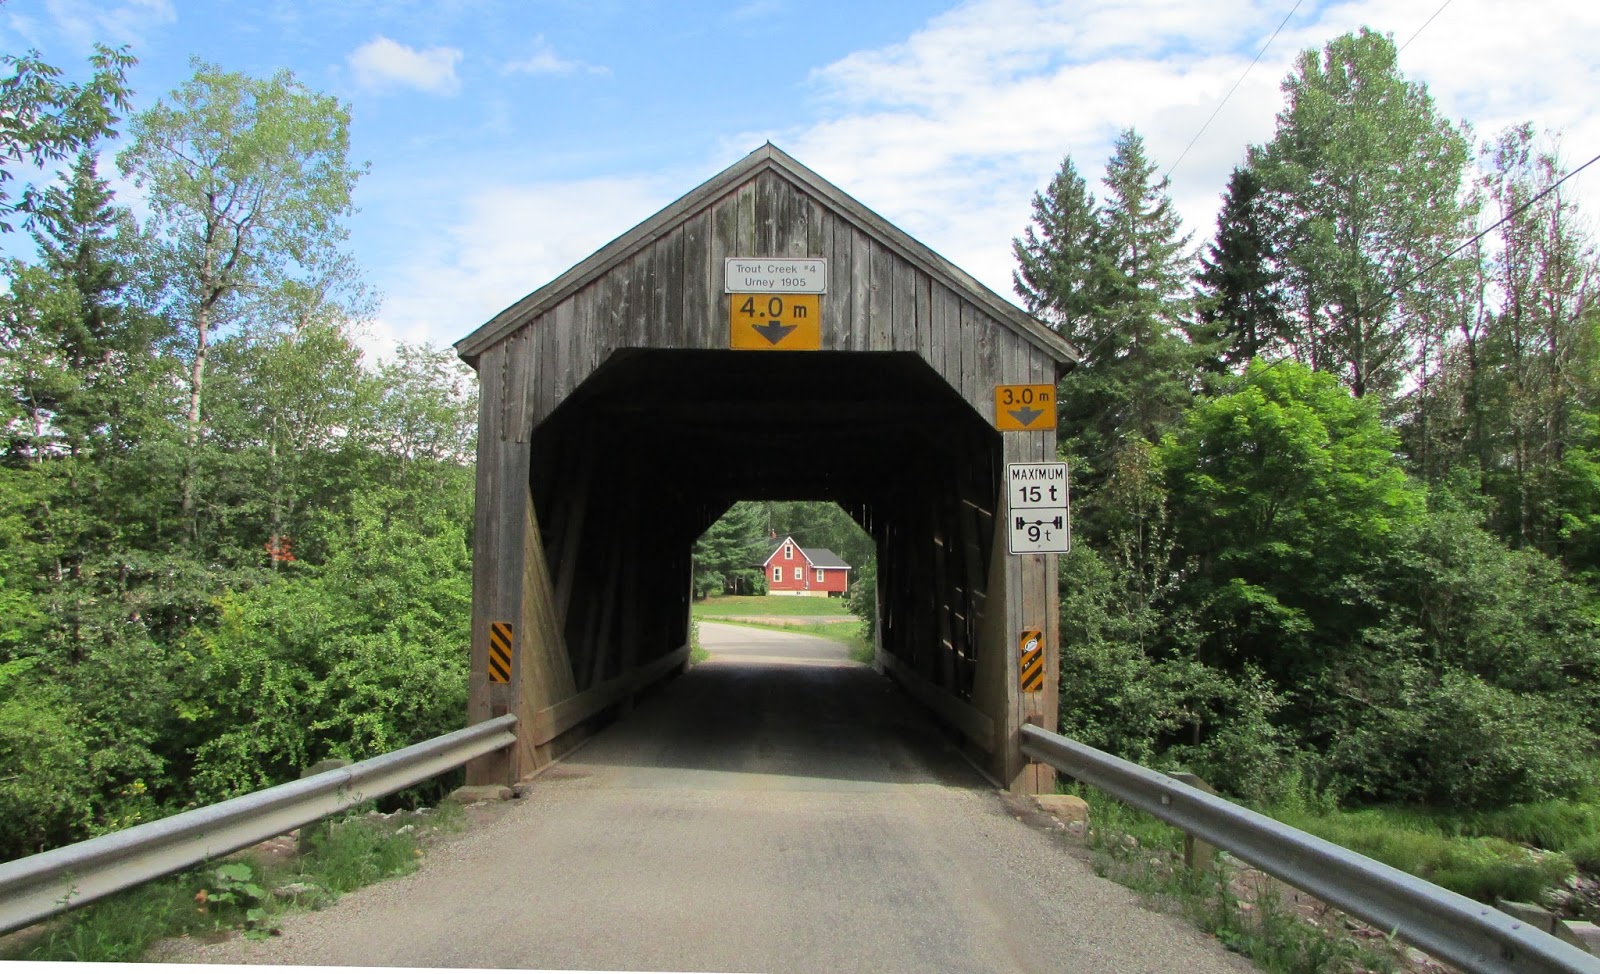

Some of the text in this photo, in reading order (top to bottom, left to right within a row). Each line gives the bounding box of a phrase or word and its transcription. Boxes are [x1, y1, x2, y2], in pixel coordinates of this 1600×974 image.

[736, 264, 761, 274] Trout
[767, 264, 798, 274] Creek
[745, 277, 806, 288] Urney 1905
[739, 296, 807, 318] 4.0 m
[1002, 388, 1049, 405] 3.0 m
[1012, 468, 1063, 481] MAXIMUM
[1018, 484, 1058, 503] 15 t
[1027, 525, 1052, 542] 9 t
